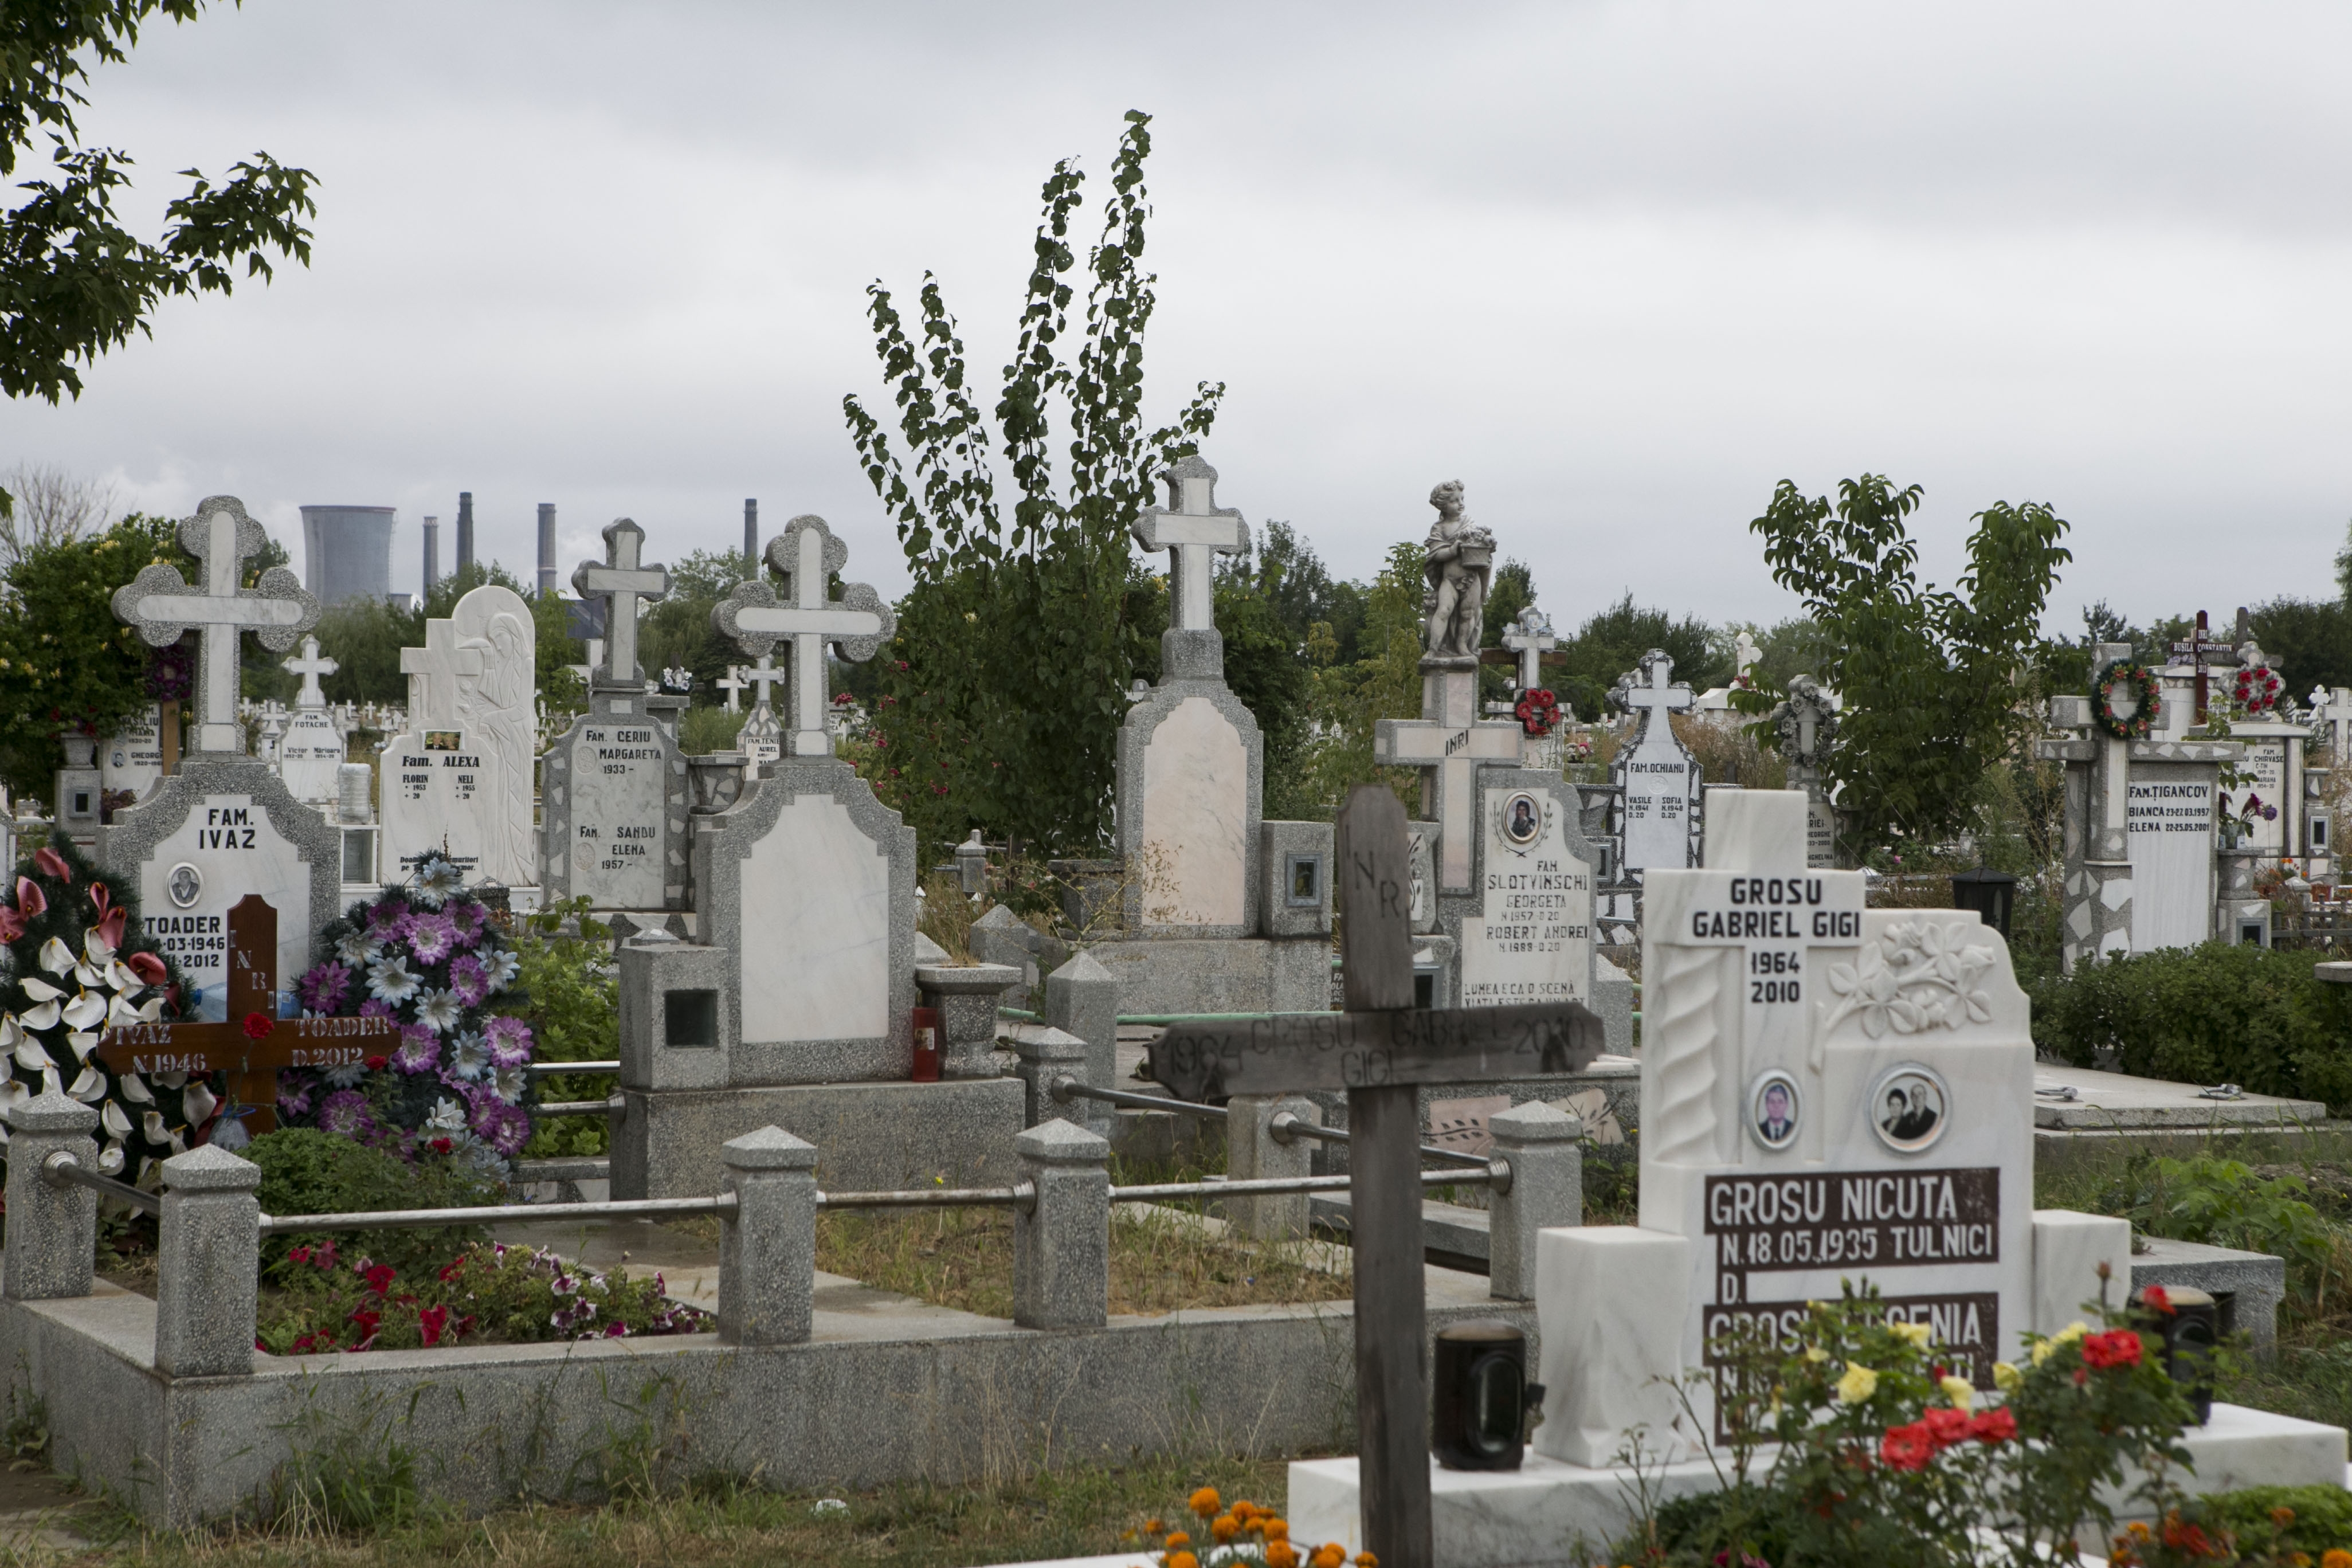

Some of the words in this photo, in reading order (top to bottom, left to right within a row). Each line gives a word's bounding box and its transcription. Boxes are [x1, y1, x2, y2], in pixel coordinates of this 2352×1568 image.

[2197, 644, 2232, 652] CONSTANTIN
[617, 731, 650, 742] CERIU
[1445, 730, 1468, 756] INRI
[402, 755, 433, 767] Fam.
[443, 756, 480, 767] ALEXA
[402, 774, 428, 783] FLORIN
[458, 775, 473, 783] NELI
[208, 809, 254, 826] FAM.
[2128, 807, 2165, 817] BIANCA
[617, 827, 655, 838] SANDU
[2129, 822, 2161, 832] ELENA
[199, 829, 256, 849] IVAZ
[612, 845, 645, 855] ELENA
[1488, 875, 1588, 891] SLOTVINSCHI
[1731, 878, 1821, 905] GROSU
[1506, 895, 1566, 908] GEORGETA
[144, 916, 220, 934] TOADER
[1487, 926, 1537, 940] ROBERT
[1545, 926, 1587, 939] ANDREI
[1694, 911, 1801, 938] GABRIEL
[1812, 911, 1860, 938] GIGI
[1751, 951, 1801, 974] 1964
[1465, 983, 1499, 995] LUMEA
[1751, 981, 1800, 1003] 2010
[115, 1024, 171, 1045] IVAZ
[295, 1016, 389, 1038] TOADER
[132, 1053, 206, 1073] N.1946
[291, 1047, 363, 1068] D.2012
[1711, 1180, 1826, 1226] GROSU
[1841, 1176, 1958, 1222] NICUTA
[1892, 1224, 1992, 1259] TULNICI
[1722, 1272, 1743, 1305] D.
